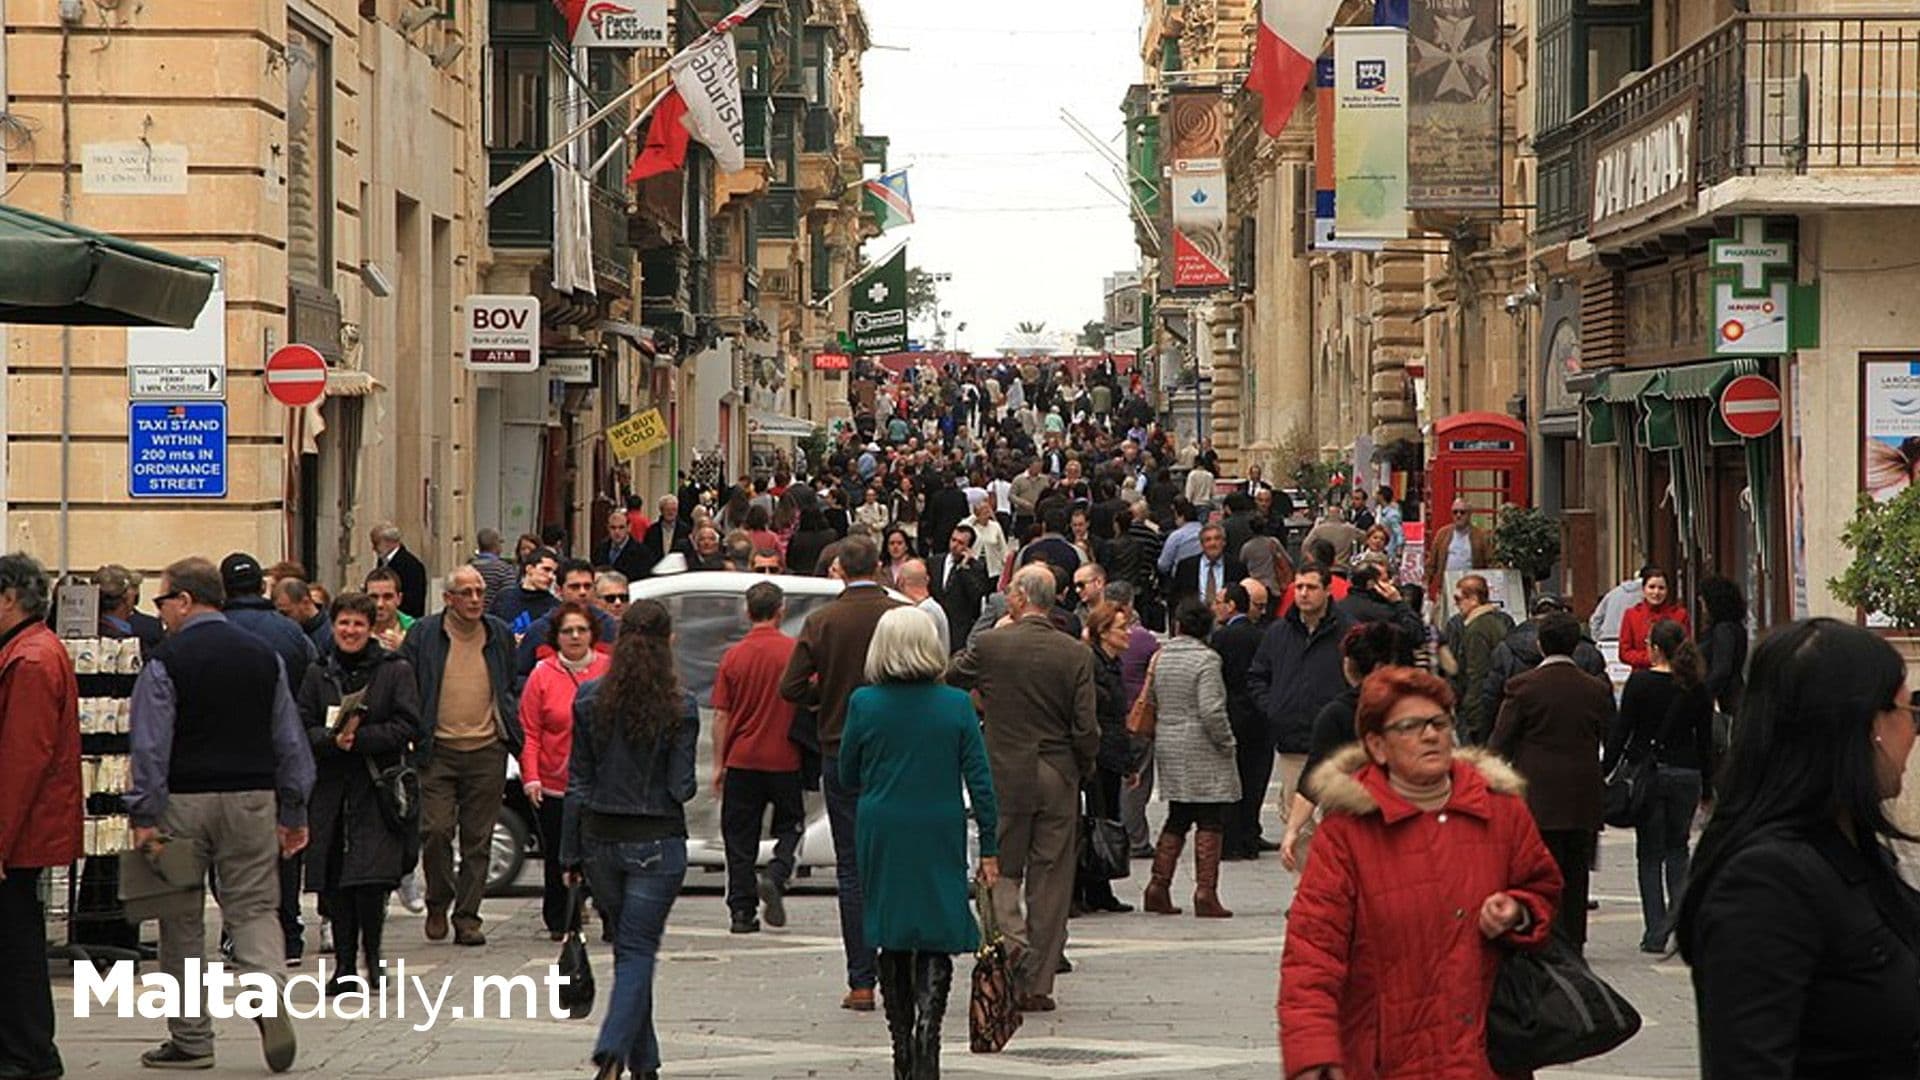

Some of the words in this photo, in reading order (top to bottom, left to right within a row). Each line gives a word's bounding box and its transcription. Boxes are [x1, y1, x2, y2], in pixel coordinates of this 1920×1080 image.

[606, 15, 638, 28] Partit
[606, 27, 662, 40] Laburista
[1724, 248, 1778, 256] PHARMACY
[473, 308, 529, 330] BOV
[473, 336, 489, 344] Bank
[501, 336, 529, 344] Valletta
[857, 333, 904, 347] PHARMACY
[487, 351, 516, 361] ATM
[136, 419, 168, 431] TAXI
[170, 419, 220, 431] STAND
[611, 422, 632, 440] WE
[632, 411, 656, 432] BUY
[150, 434, 204, 446] WITHIN
[622, 426, 656, 448] GOLD
[141, 448, 166, 461] 200
[168, 449, 195, 461] mts
[198, 448, 214, 461] IN
[133, 463, 221, 476] ORDINANCE
[148, 477, 206, 490] STREET
